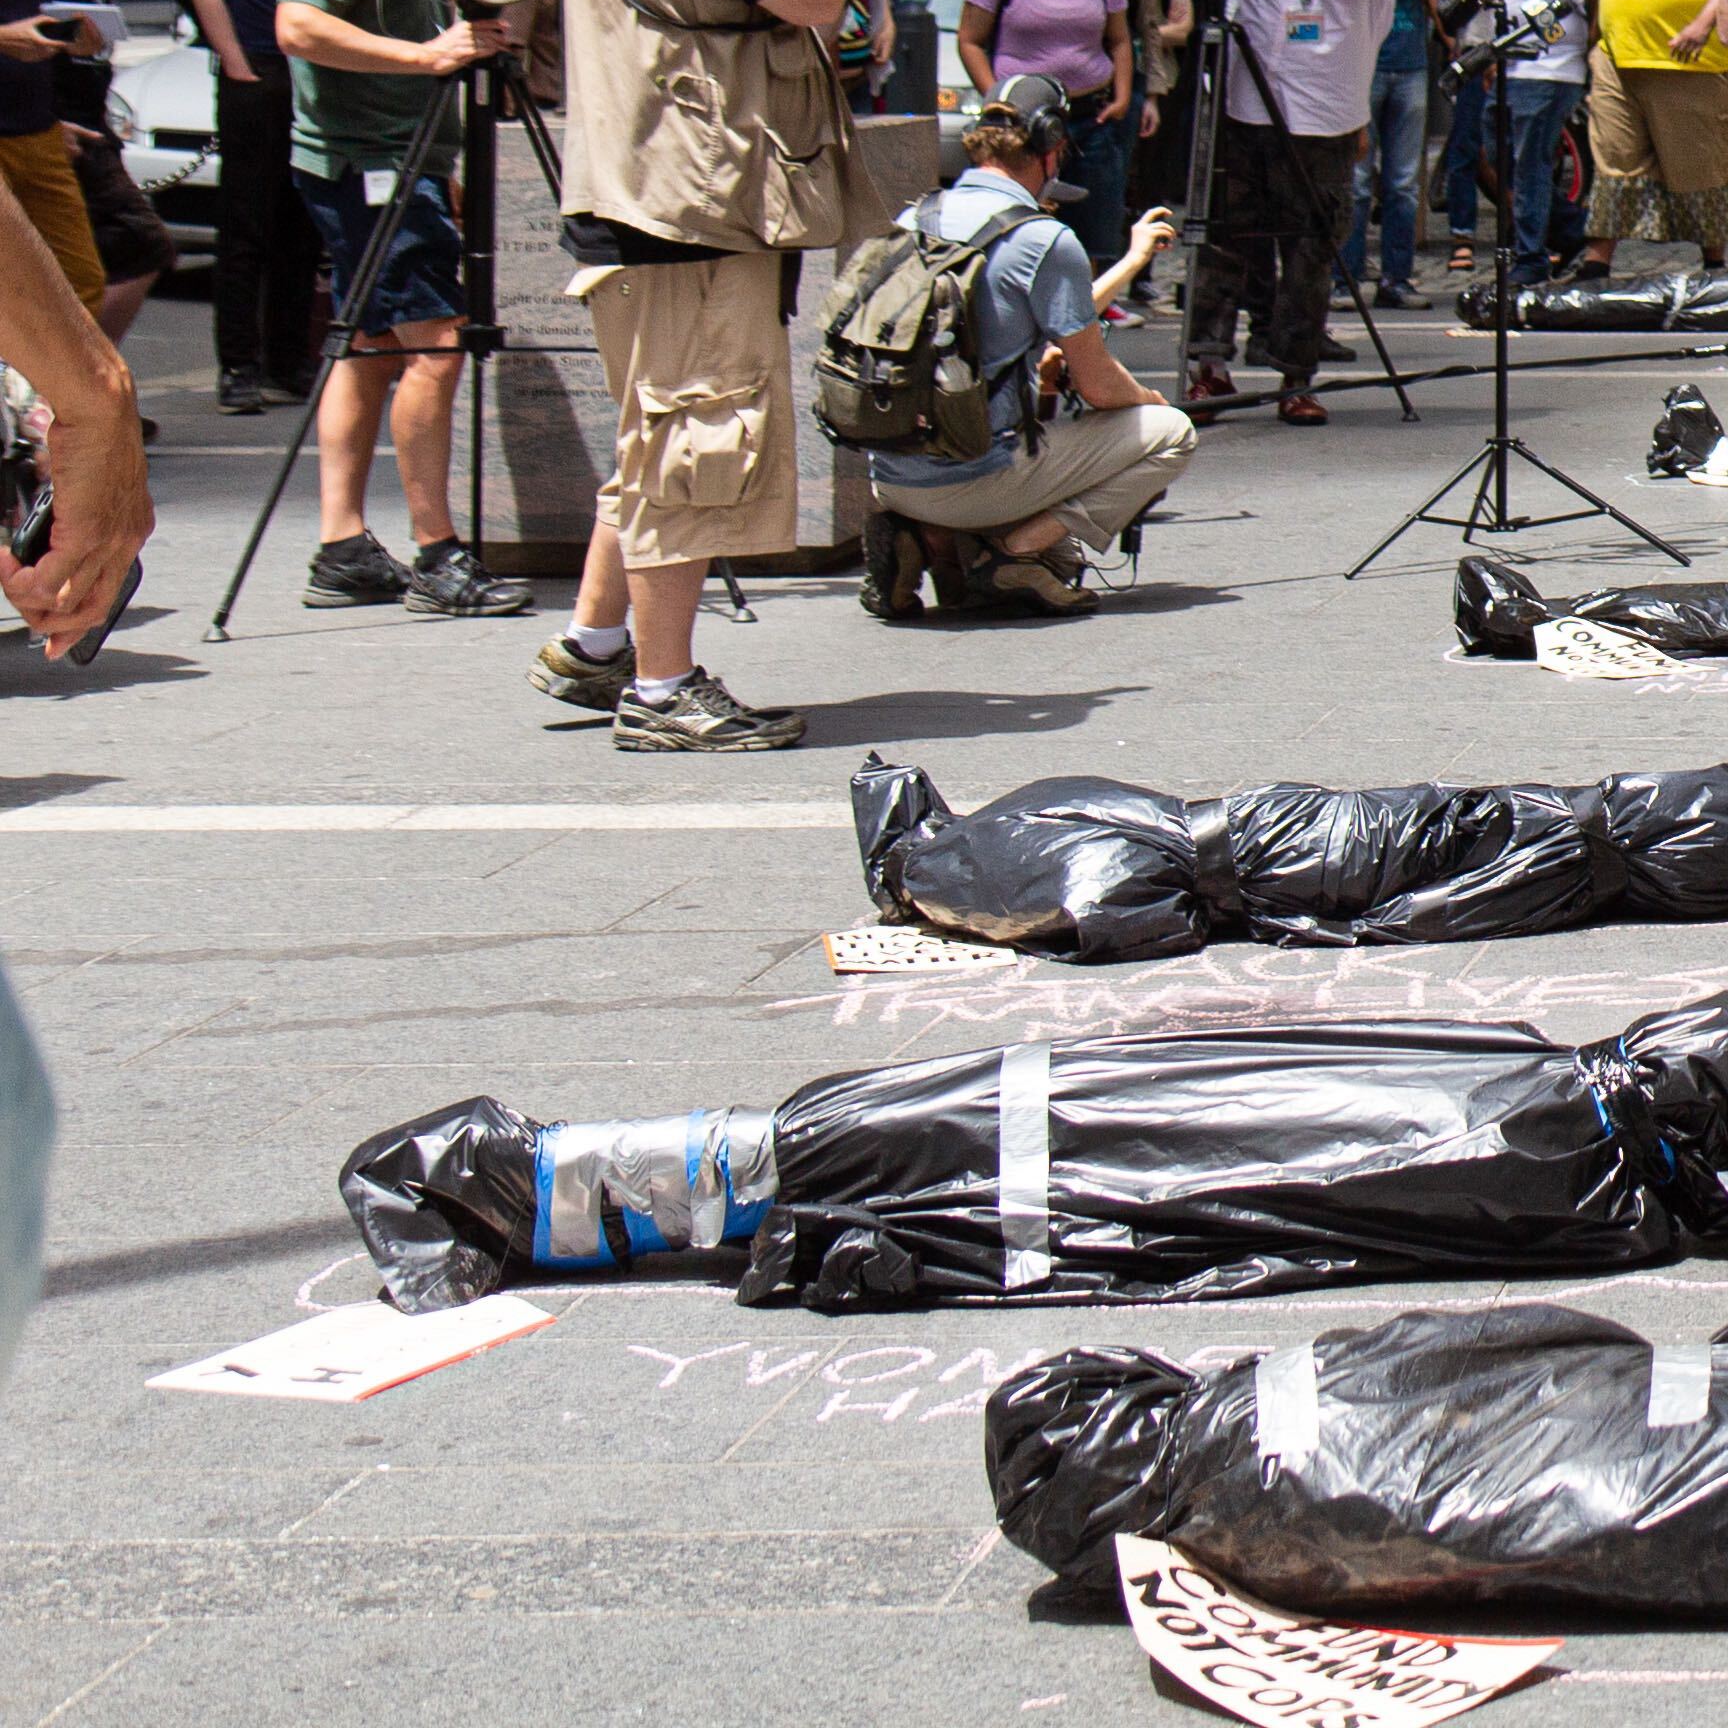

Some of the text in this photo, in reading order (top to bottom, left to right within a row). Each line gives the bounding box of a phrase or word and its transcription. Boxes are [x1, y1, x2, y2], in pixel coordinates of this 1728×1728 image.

[1127, 1569, 1260, 1659] NOT
[1169, 1566, 1500, 1710] COMMUNITY
[1283, 1621, 1459, 1668] FUND
